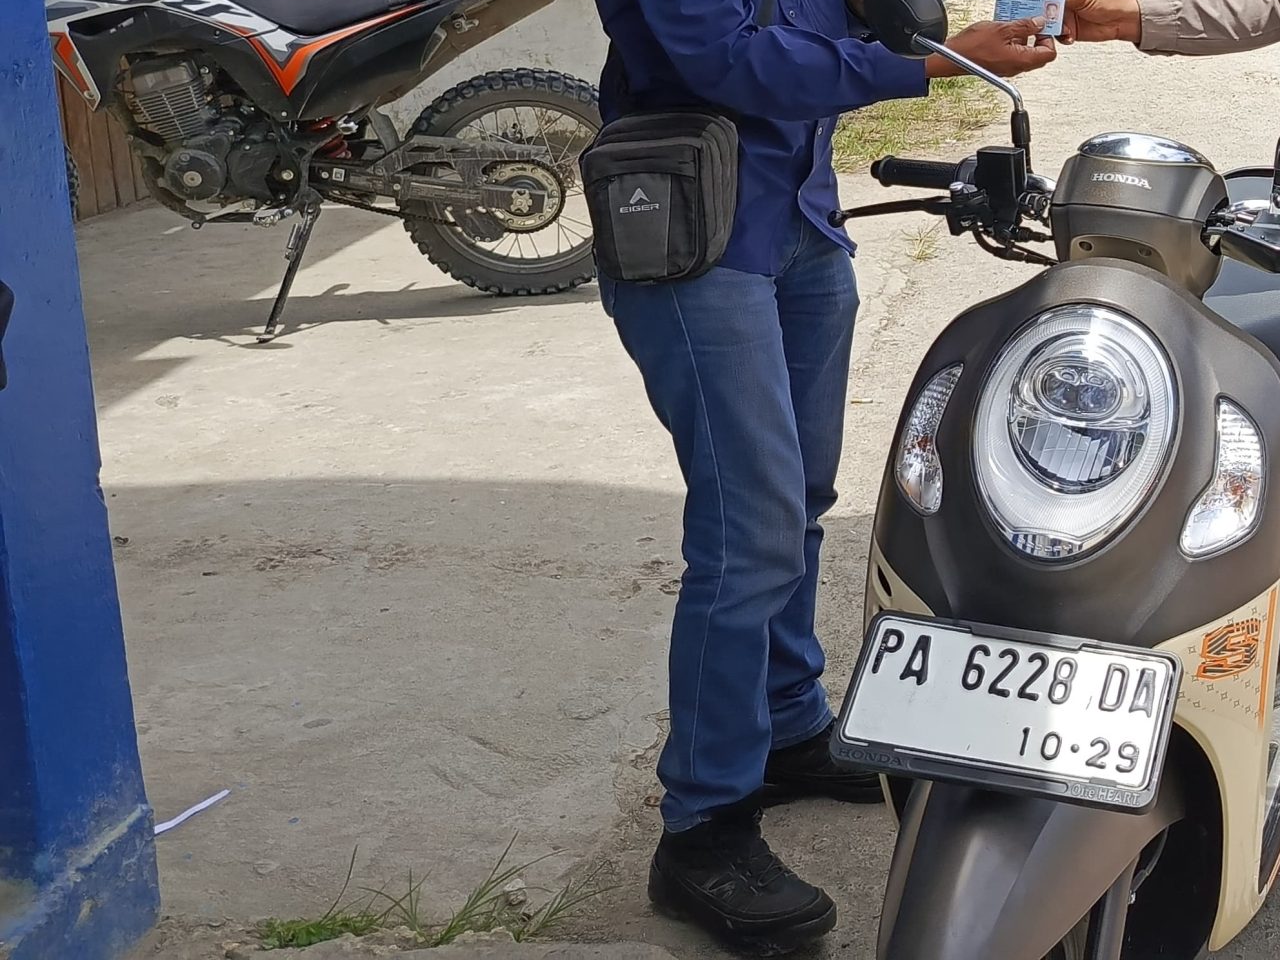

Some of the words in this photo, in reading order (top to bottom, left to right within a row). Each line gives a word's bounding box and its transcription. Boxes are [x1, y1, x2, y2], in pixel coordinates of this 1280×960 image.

[1091, 173, 1152, 190] HONDA
[619, 203, 660, 214] EIGER
[871, 628, 932, 686] PA
[961, 644, 1078, 705] 6228
[1098, 662, 1157, 718] DA
[838, 747, 903, 767] HONDA
[1071, 783, 1096, 799] One
